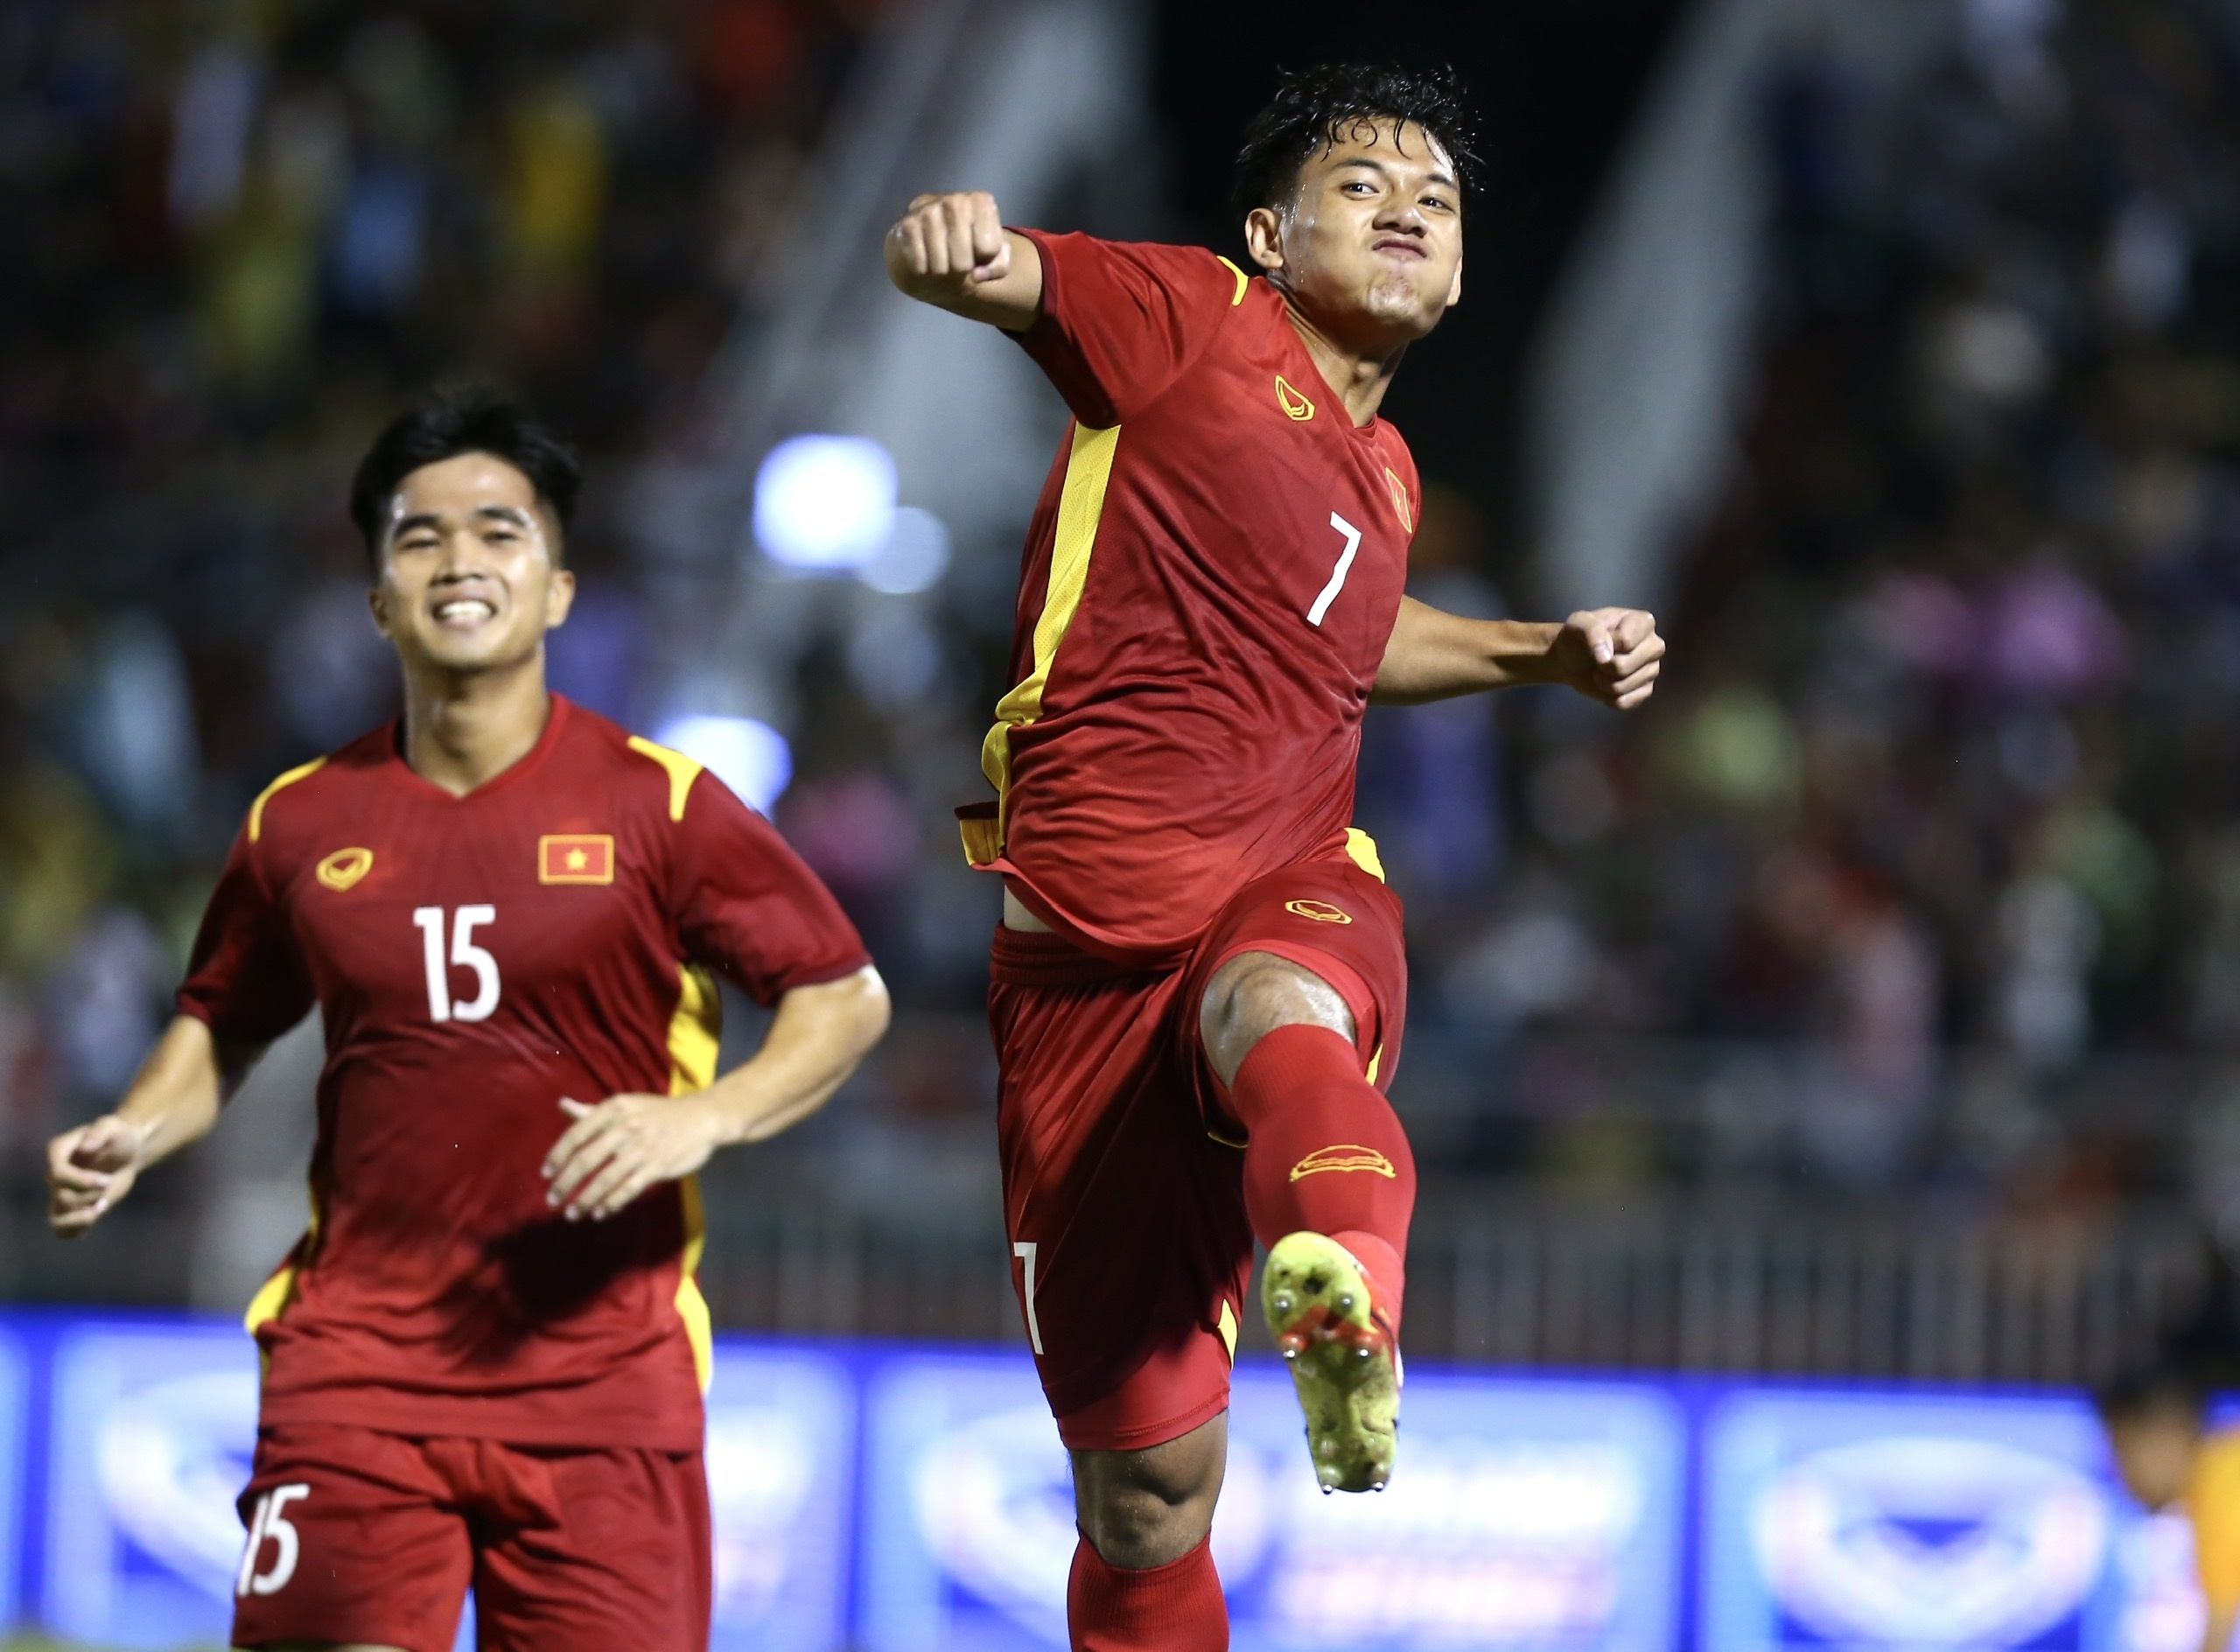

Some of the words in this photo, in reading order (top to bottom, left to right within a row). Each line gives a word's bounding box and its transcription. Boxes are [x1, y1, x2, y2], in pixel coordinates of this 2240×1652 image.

[1306, 509, 1362, 627] 7
[413, 904, 501, 1023] 15
[237, 1482, 311, 1597] 15
